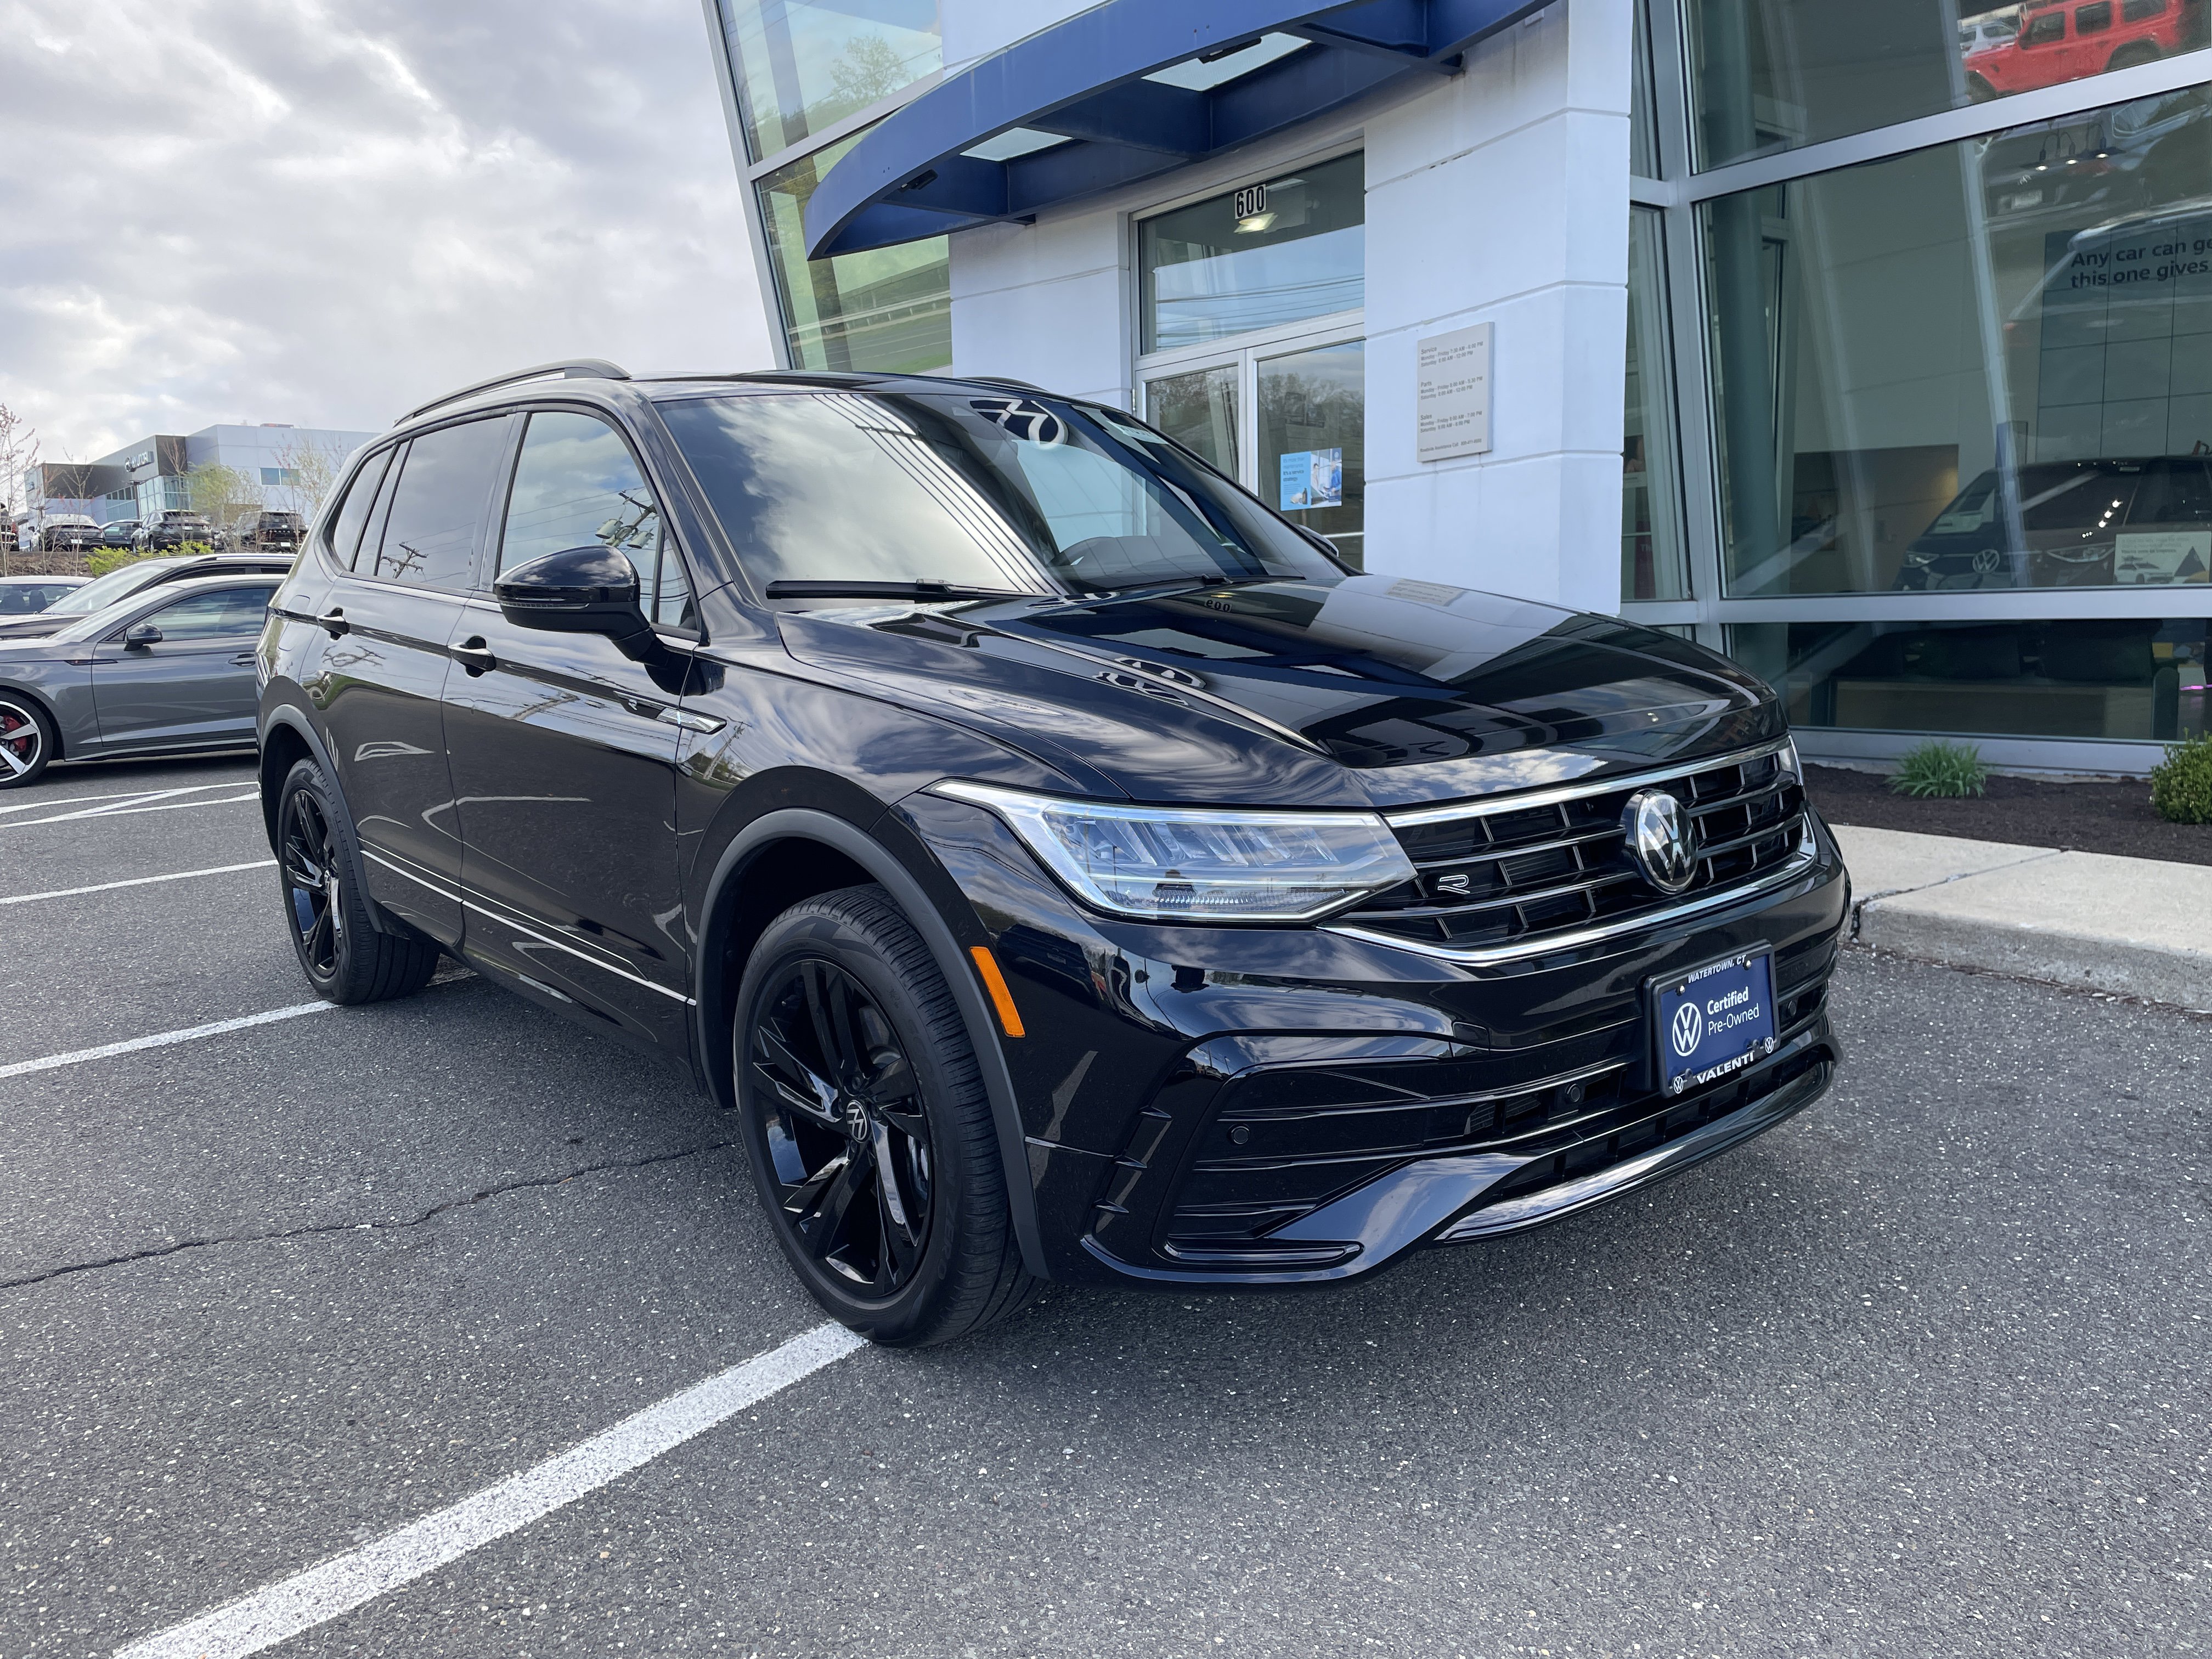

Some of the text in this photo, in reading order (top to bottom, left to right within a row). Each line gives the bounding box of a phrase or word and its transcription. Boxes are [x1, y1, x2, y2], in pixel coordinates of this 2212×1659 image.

[1236, 185, 1265, 217] 600
[2071, 251, 2109, 268] Any
[2116, 246, 2146, 262] car
[2152, 240, 2186, 257] can
[2070, 259, 2209, 289] this one gives
[1736, 954, 1747, 965] CT
[1707, 986, 1749, 1015] Certified
[1707, 1002, 1760, 1037] Pre-Owned
[1696, 1050, 1755, 1085] VALENTI
